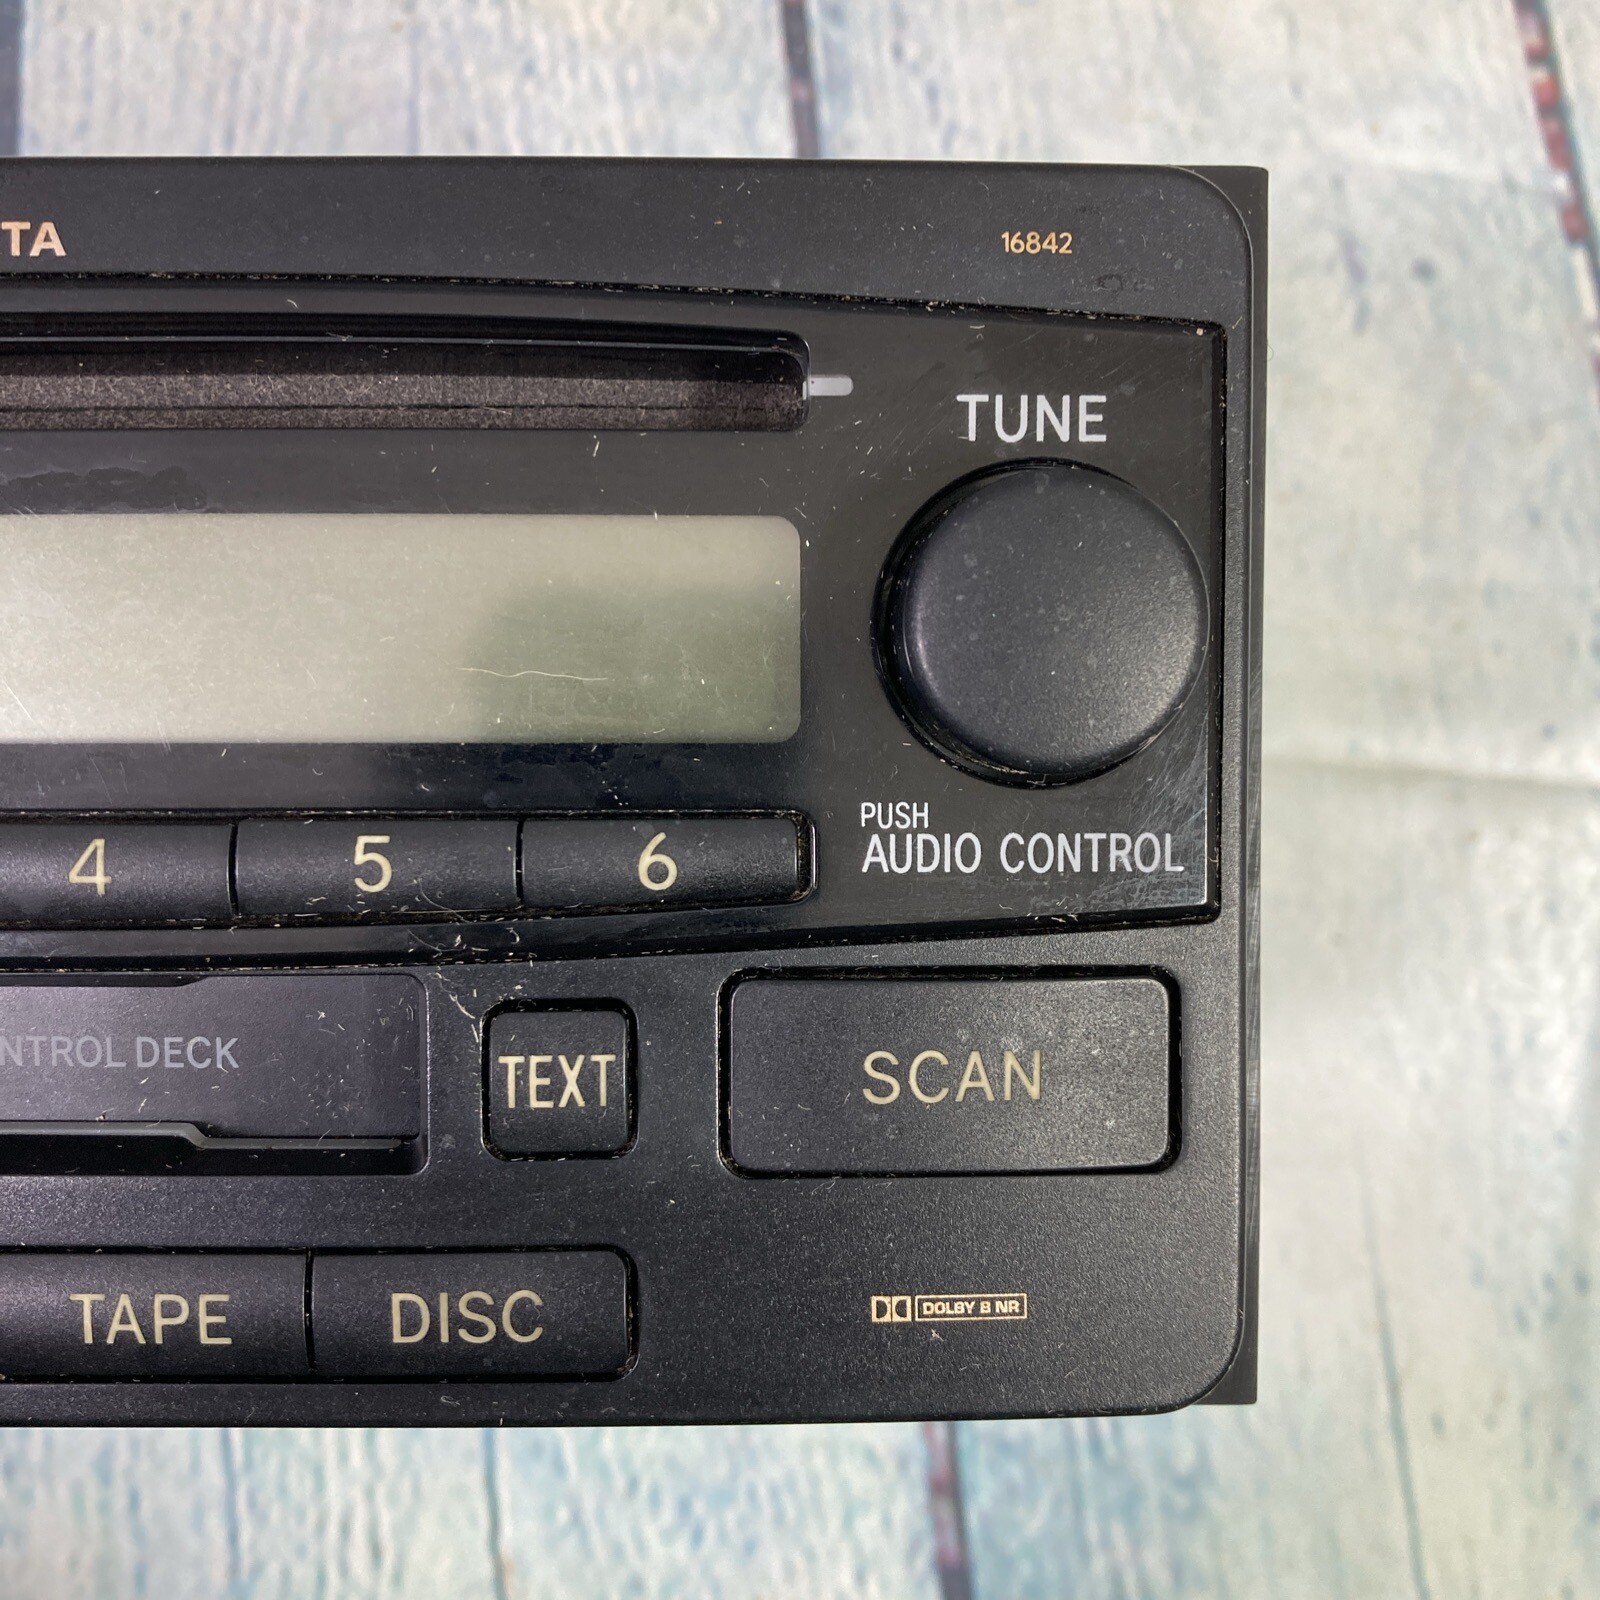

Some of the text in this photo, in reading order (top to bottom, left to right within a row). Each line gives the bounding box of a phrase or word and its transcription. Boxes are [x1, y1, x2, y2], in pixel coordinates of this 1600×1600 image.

[1, 221, 67, 257] TA
[1001, 231, 1074, 256] 16842
[956, 393, 1108, 444] TUNE
[859, 801, 931, 829] PUSH
[68, 838, 112, 896] 4
[352, 834, 393, 894] 5
[637, 831, 678, 892] 6
[861, 831, 1185, 875] AUDIO CONTROL
[0, 1034, 240, 1070] NTROL DECK
[862, 1048, 1042, 1106] SCAN
[498, 1054, 616, 1110] TEXT
[70, 1292, 233, 1346] TAPE
[390, 1289, 543, 1345] DISC
[922, 1300, 1020, 1315] DOLBY B NR
